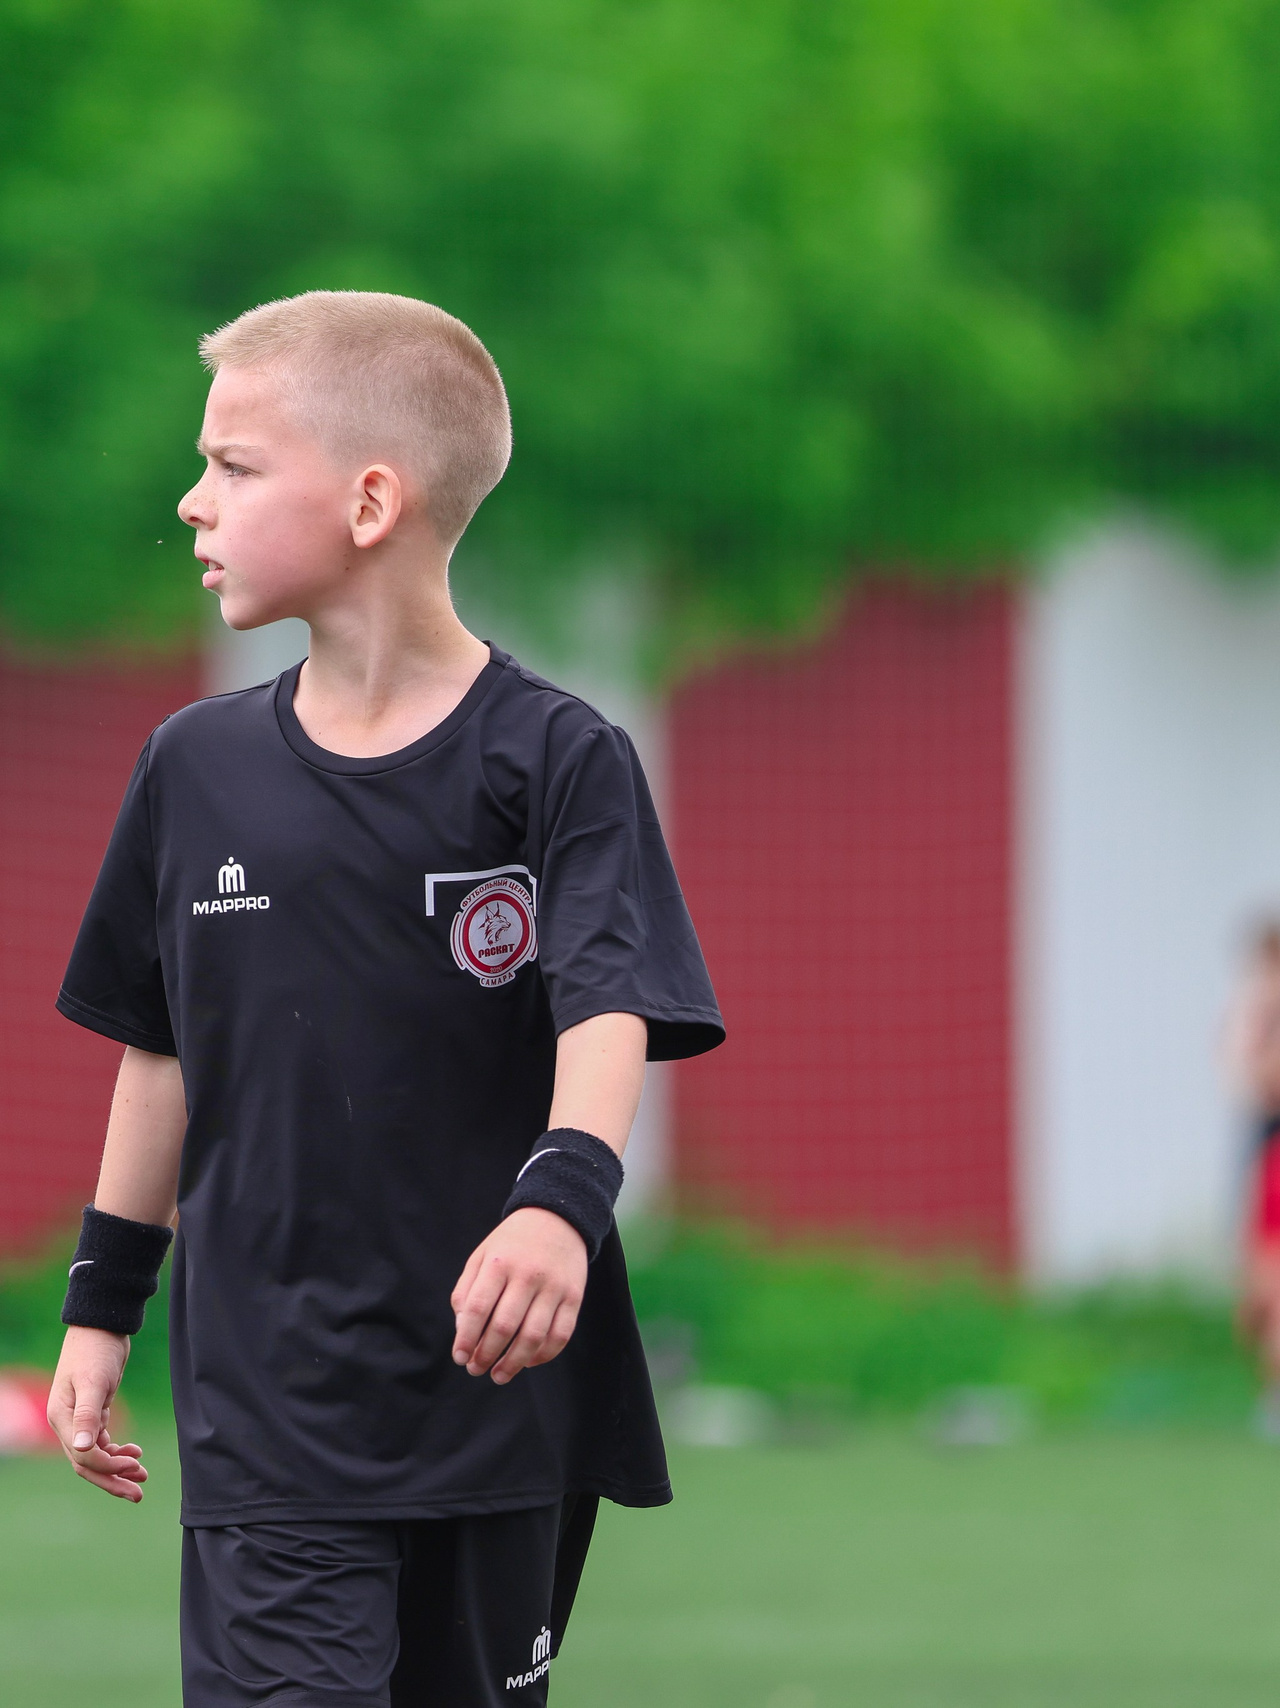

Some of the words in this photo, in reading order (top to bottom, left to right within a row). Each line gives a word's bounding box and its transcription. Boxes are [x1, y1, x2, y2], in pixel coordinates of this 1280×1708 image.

[461, 878, 508, 908] ФУТБОЛЬНЫЙ
[508, 881, 531, 902] ЦЕНТР
[192, 895, 270, 916] MAPPRO
[478, 943, 515, 958] РАСКАТ
[480, 972, 514, 986] САМАРА
[506, 1654, 551, 1690] MAPP
